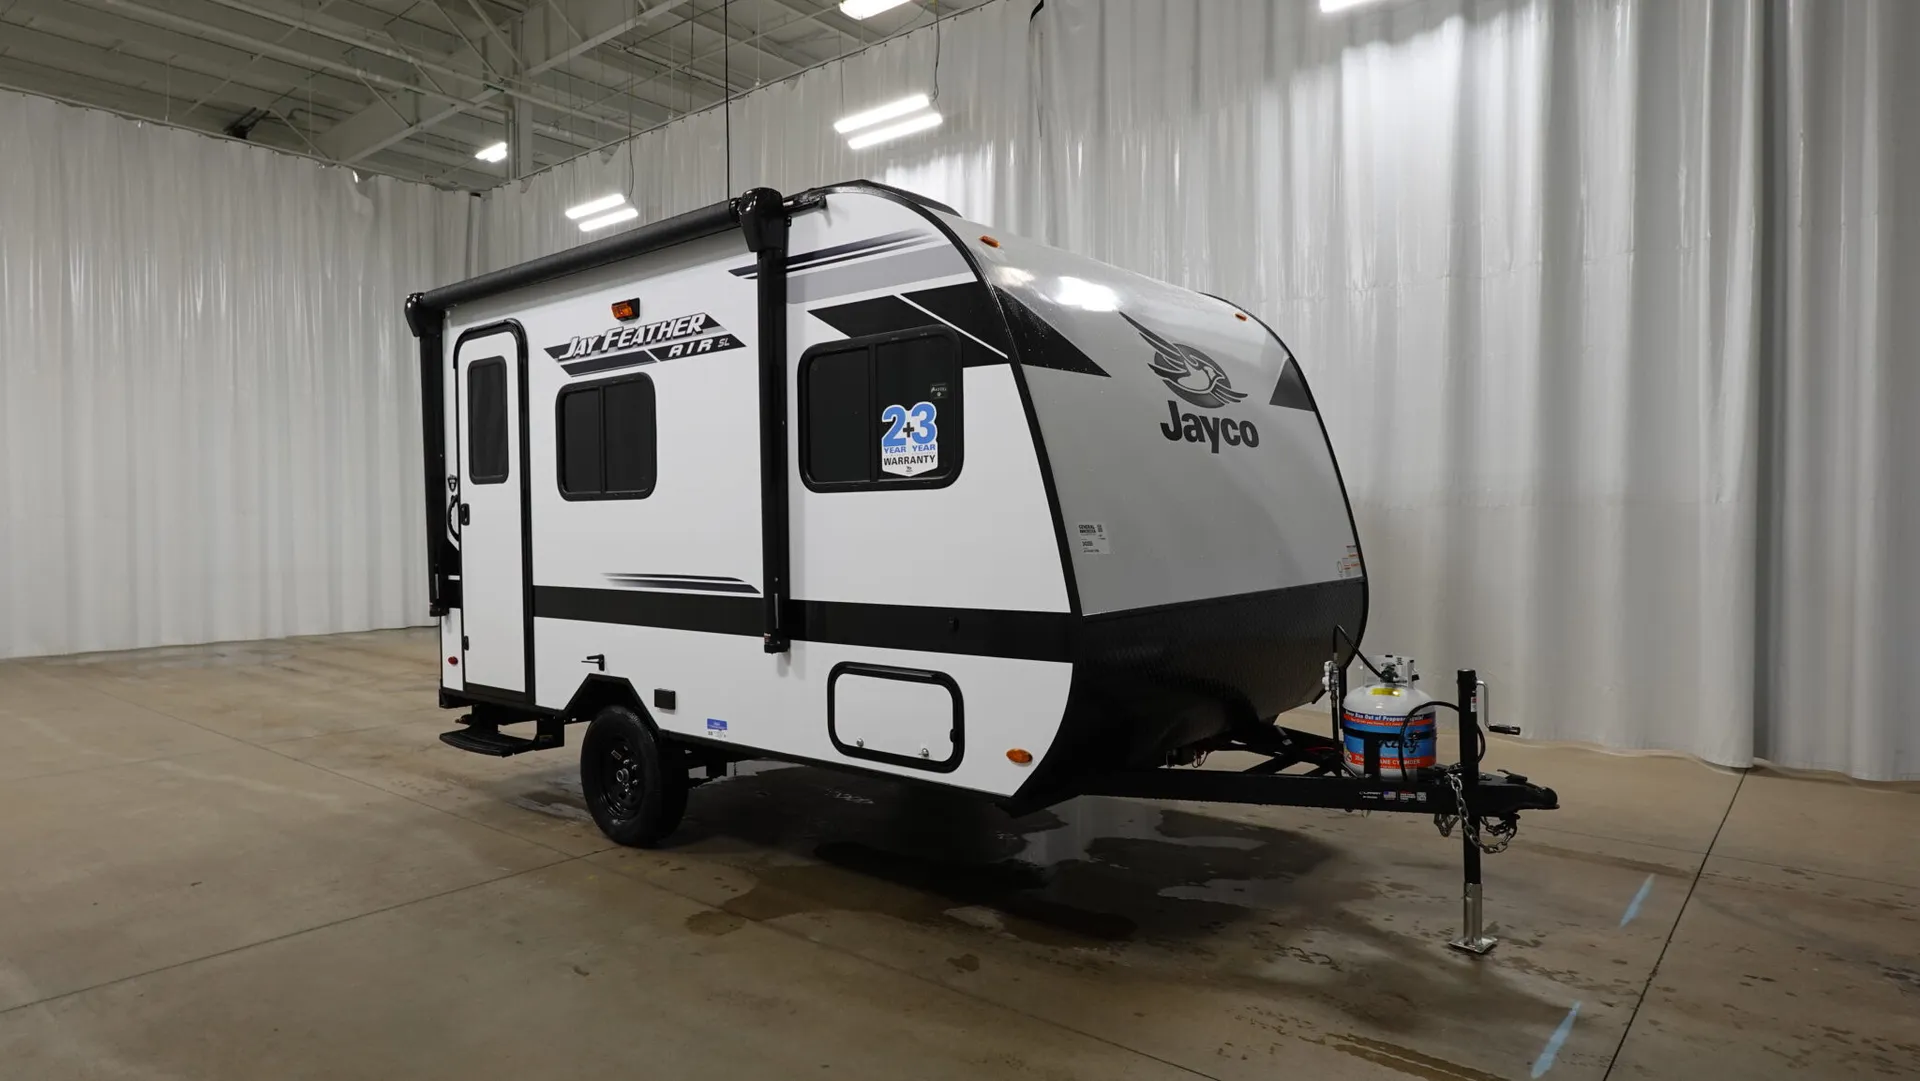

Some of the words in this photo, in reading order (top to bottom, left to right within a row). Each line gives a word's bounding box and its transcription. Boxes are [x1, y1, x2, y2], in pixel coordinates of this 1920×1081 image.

[558, 335, 601, 360] JAY
[601, 313, 706, 351] FEATHER
[668, 339, 714, 358] AIR
[718, 338, 730, 348] SL
[1160, 400, 1259, 454] Jayco
[884, 446, 906, 454] YEAR
[912, 444, 936, 452] YEAR
[883, 455, 936, 466] WARRANTY
